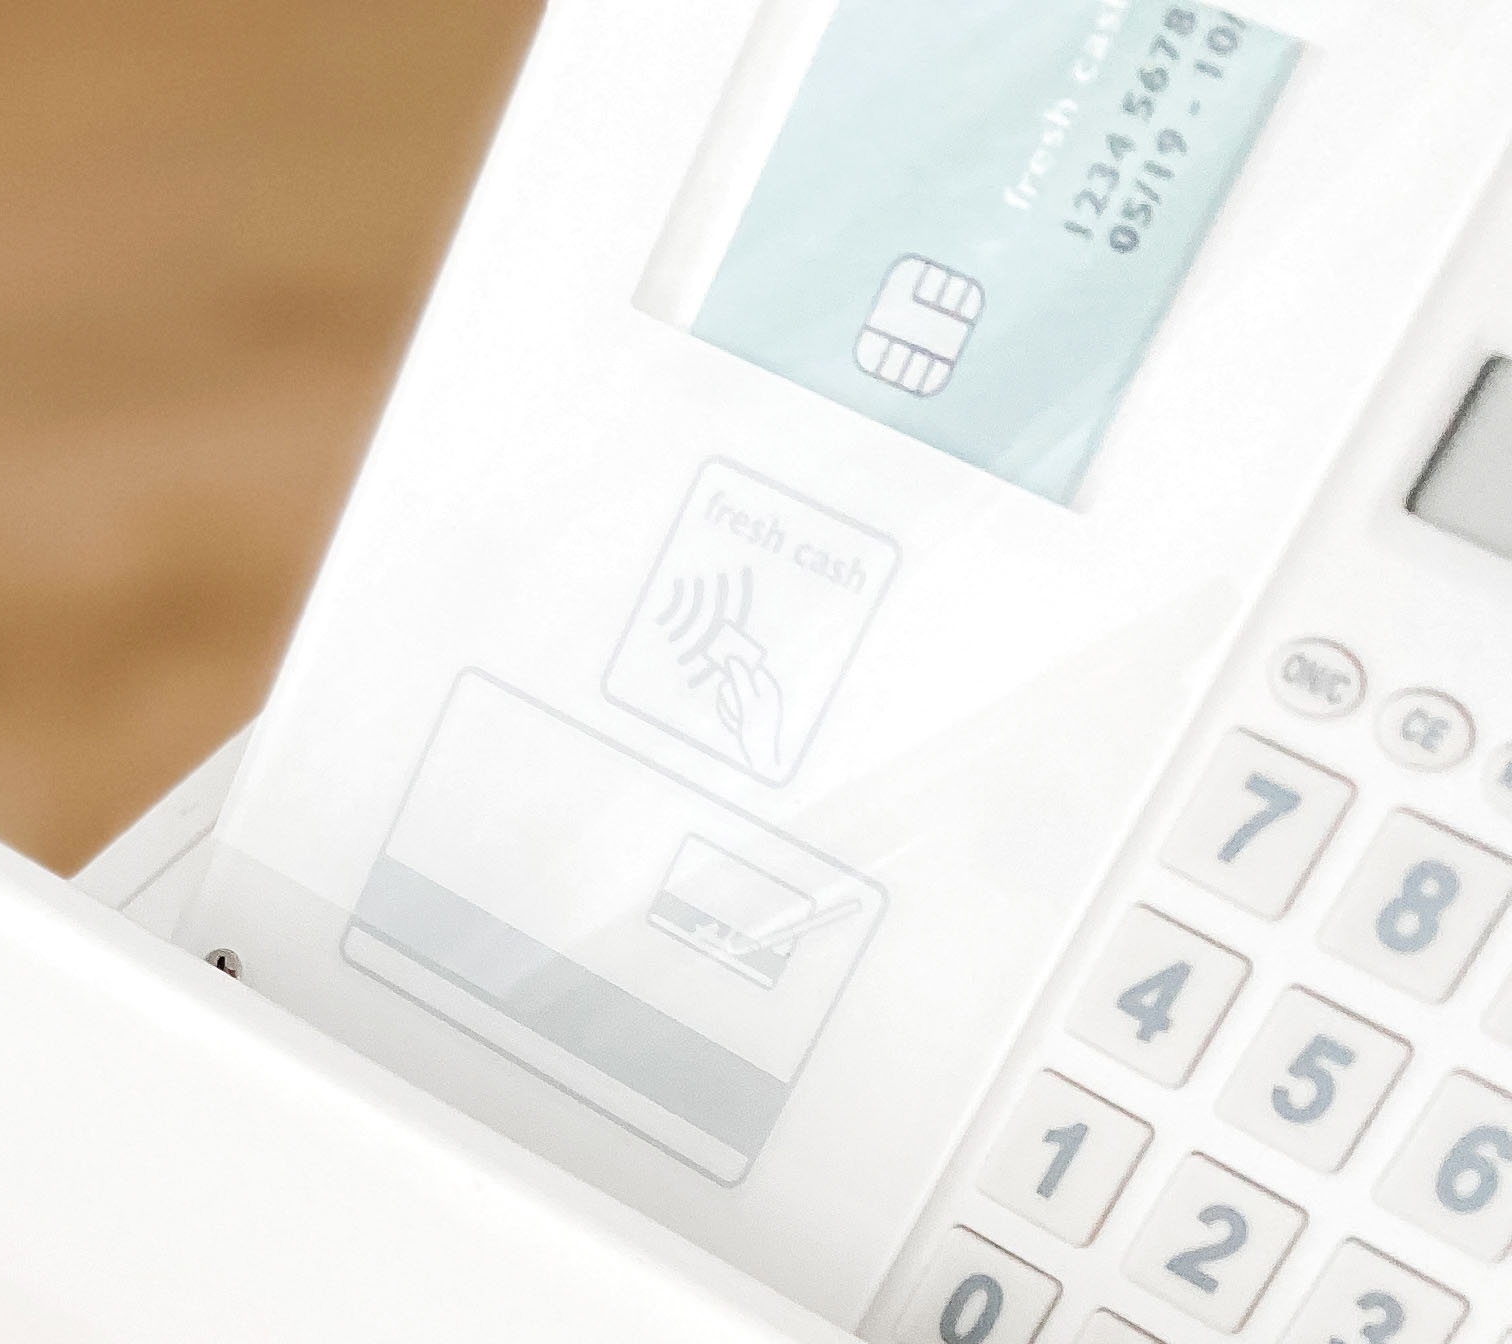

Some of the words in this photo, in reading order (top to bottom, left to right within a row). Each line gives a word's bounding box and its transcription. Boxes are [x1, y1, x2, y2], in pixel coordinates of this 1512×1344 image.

[1003, 100, 1078, 210] fresh
[1071, 0, 1128, 82] cas
[1064, 131, 1136, 240] 1234
[1120, 7, 1199, 123] 5678
[1108, 127, 1188, 255] 05/19
[704, 490, 785, 553] fresh
[792, 543, 867, 594] cash
[1218, 771, 1302, 864] 7
[1376, 860, 1460, 954] 8
[1116, 960, 1193, 1043] 4
[1272, 1034, 1355, 1124] 5
[1037, 1122, 1090, 1198] 1
[1435, 1124, 1512, 1214] 6
[1166, 1204, 1249, 1294] 2
